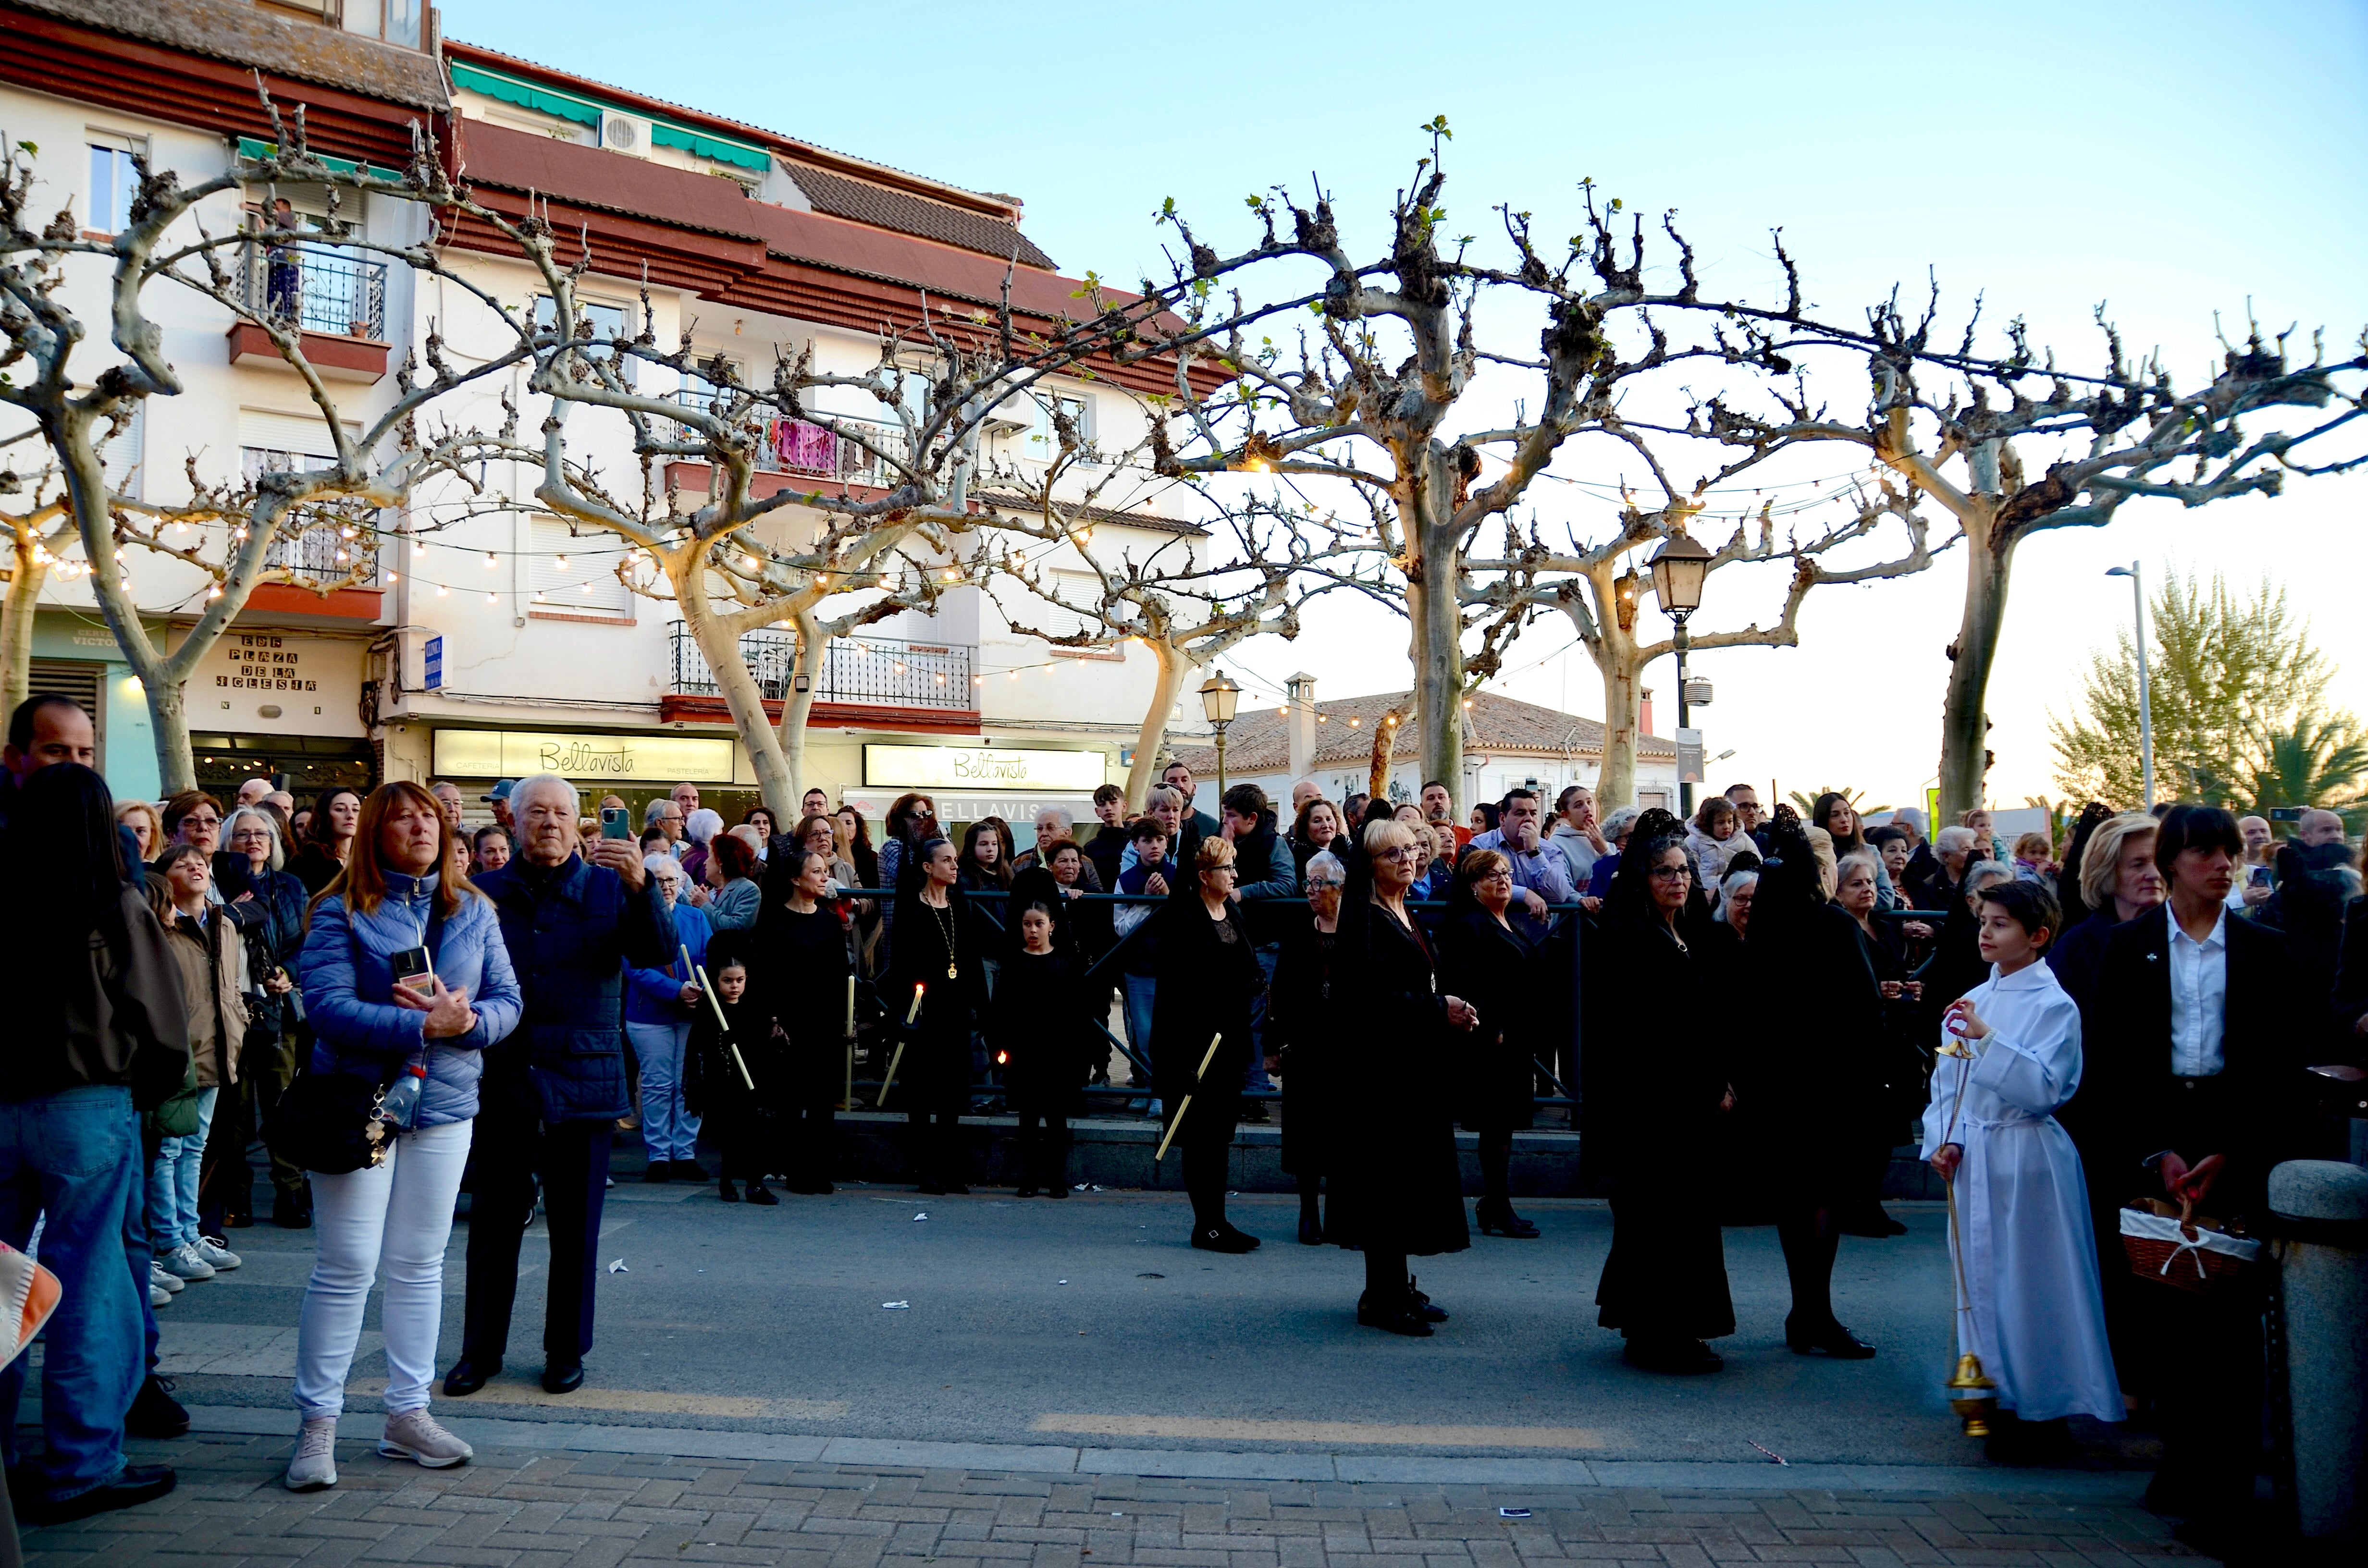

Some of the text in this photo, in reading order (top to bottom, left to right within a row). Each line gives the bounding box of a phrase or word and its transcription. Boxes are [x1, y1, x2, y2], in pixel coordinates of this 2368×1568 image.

[73, 637, 120, 647] VICTO
[230, 649, 297, 663] PLAZA
[242, 666, 295, 678] DE LA
[217, 676, 316, 691] IGLESIA
[539, 742, 635, 772] Bellavista
[954, 752, 1026, 779] Bellavista
[941, 802, 1040, 820] ELLAVIS
